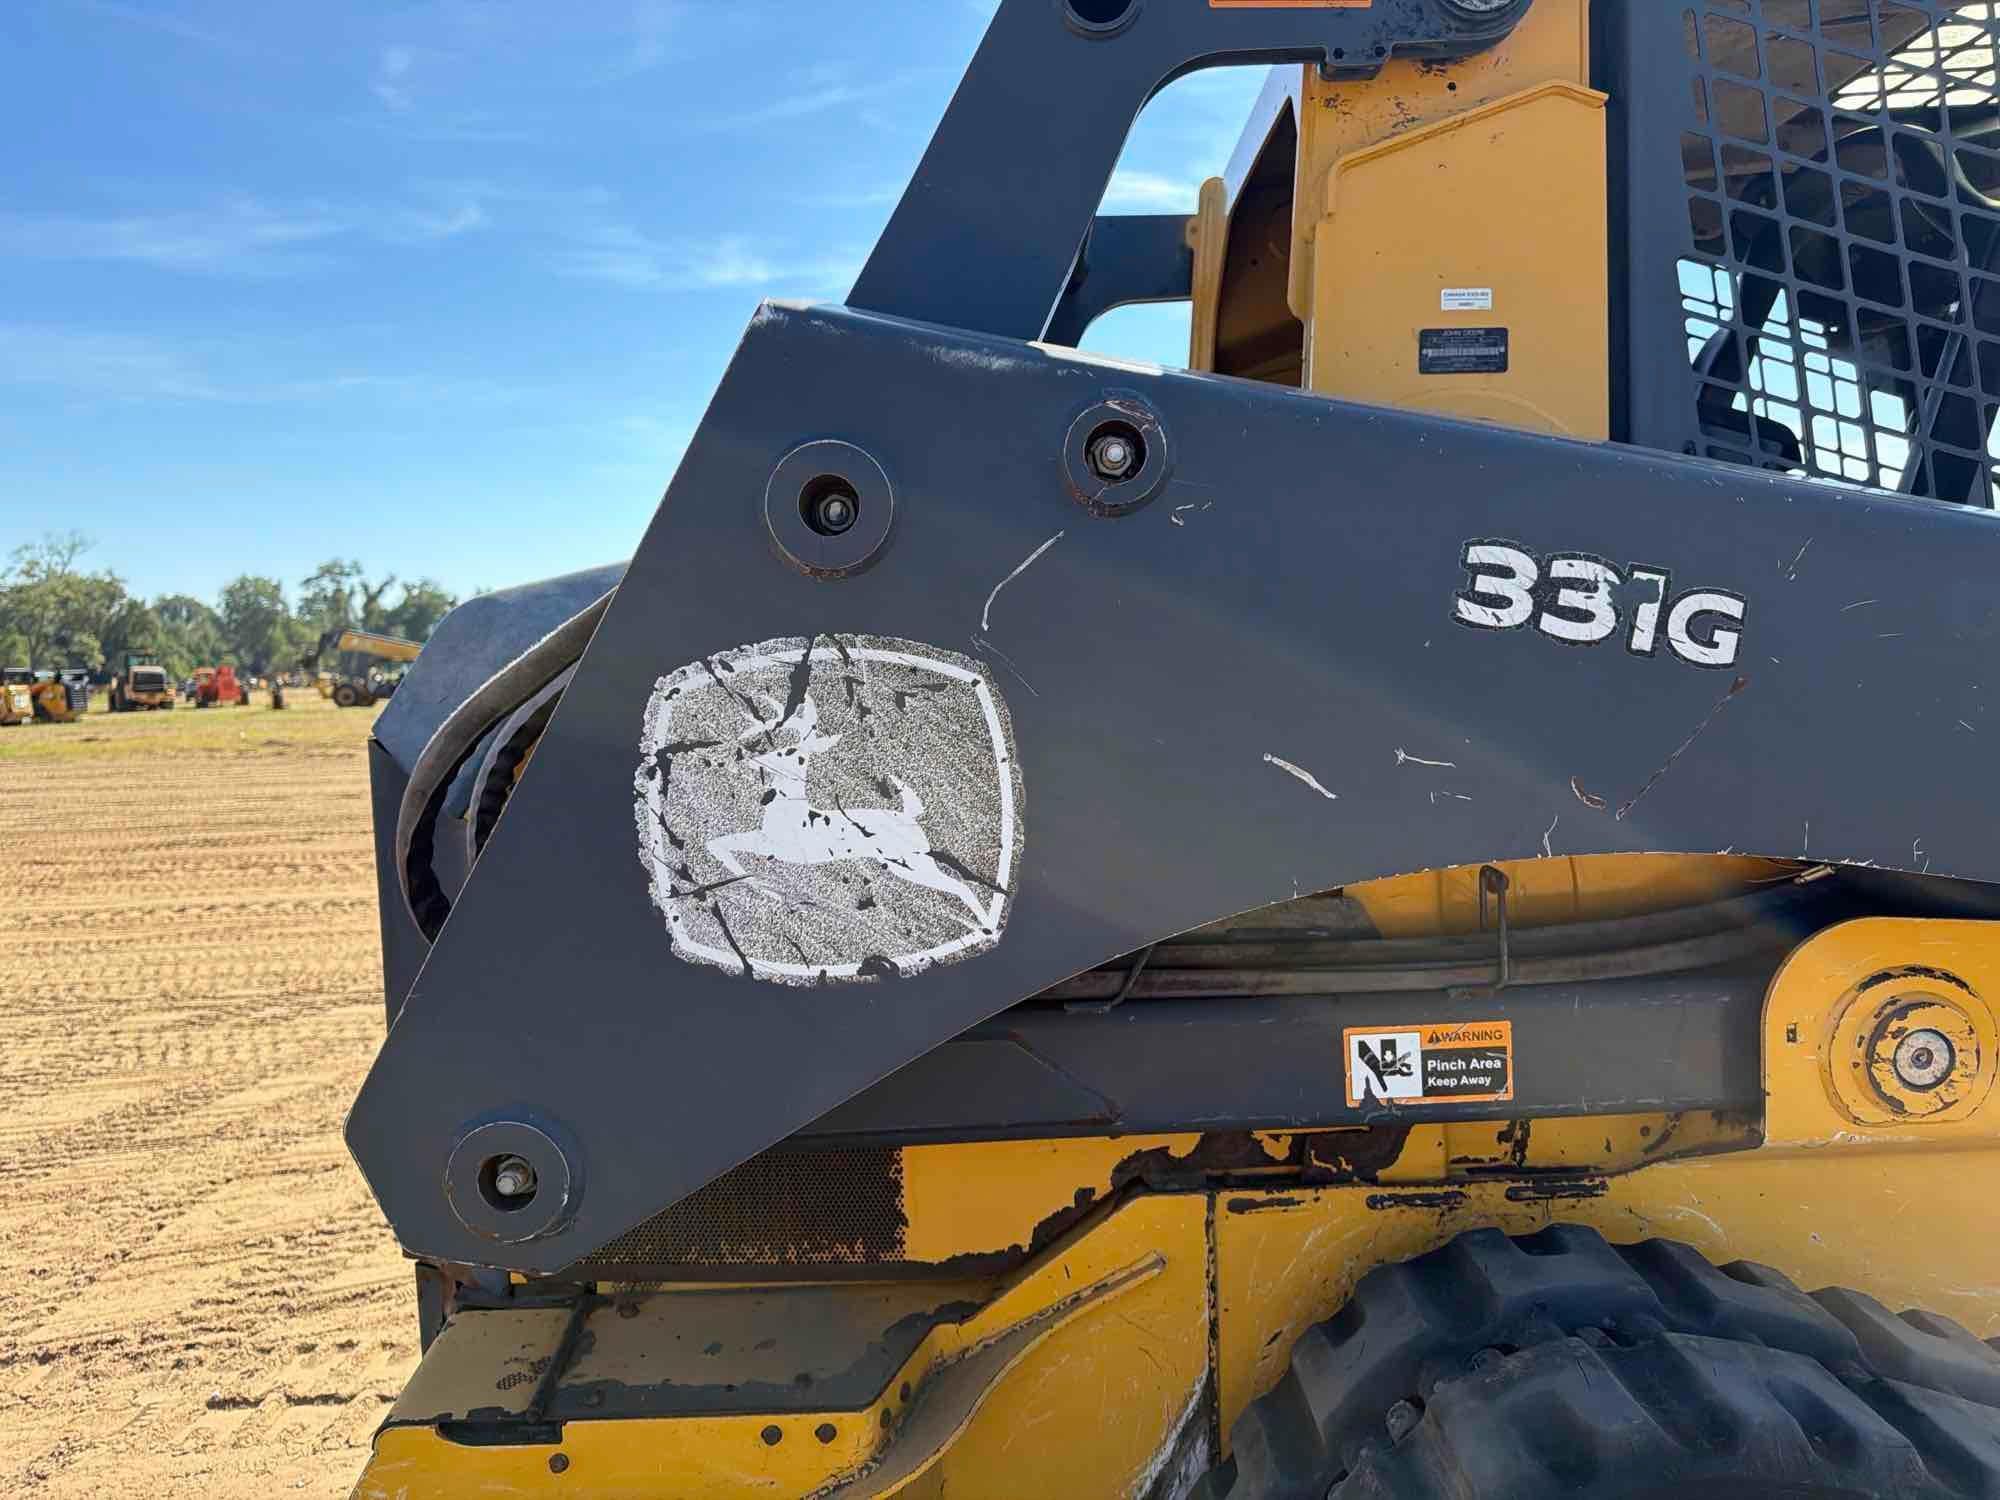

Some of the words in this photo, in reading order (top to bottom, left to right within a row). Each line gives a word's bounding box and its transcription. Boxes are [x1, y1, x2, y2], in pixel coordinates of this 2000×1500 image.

[1455, 541, 1746, 666] 331G
[1441, 1029, 1503, 1042] WARNING
[1427, 1059, 1465, 1071] Pinch
[1470, 1058, 1502, 1069] Area
[1427, 1076, 1458, 1087] Keep
[1460, 1075, 1492, 1086] Away
